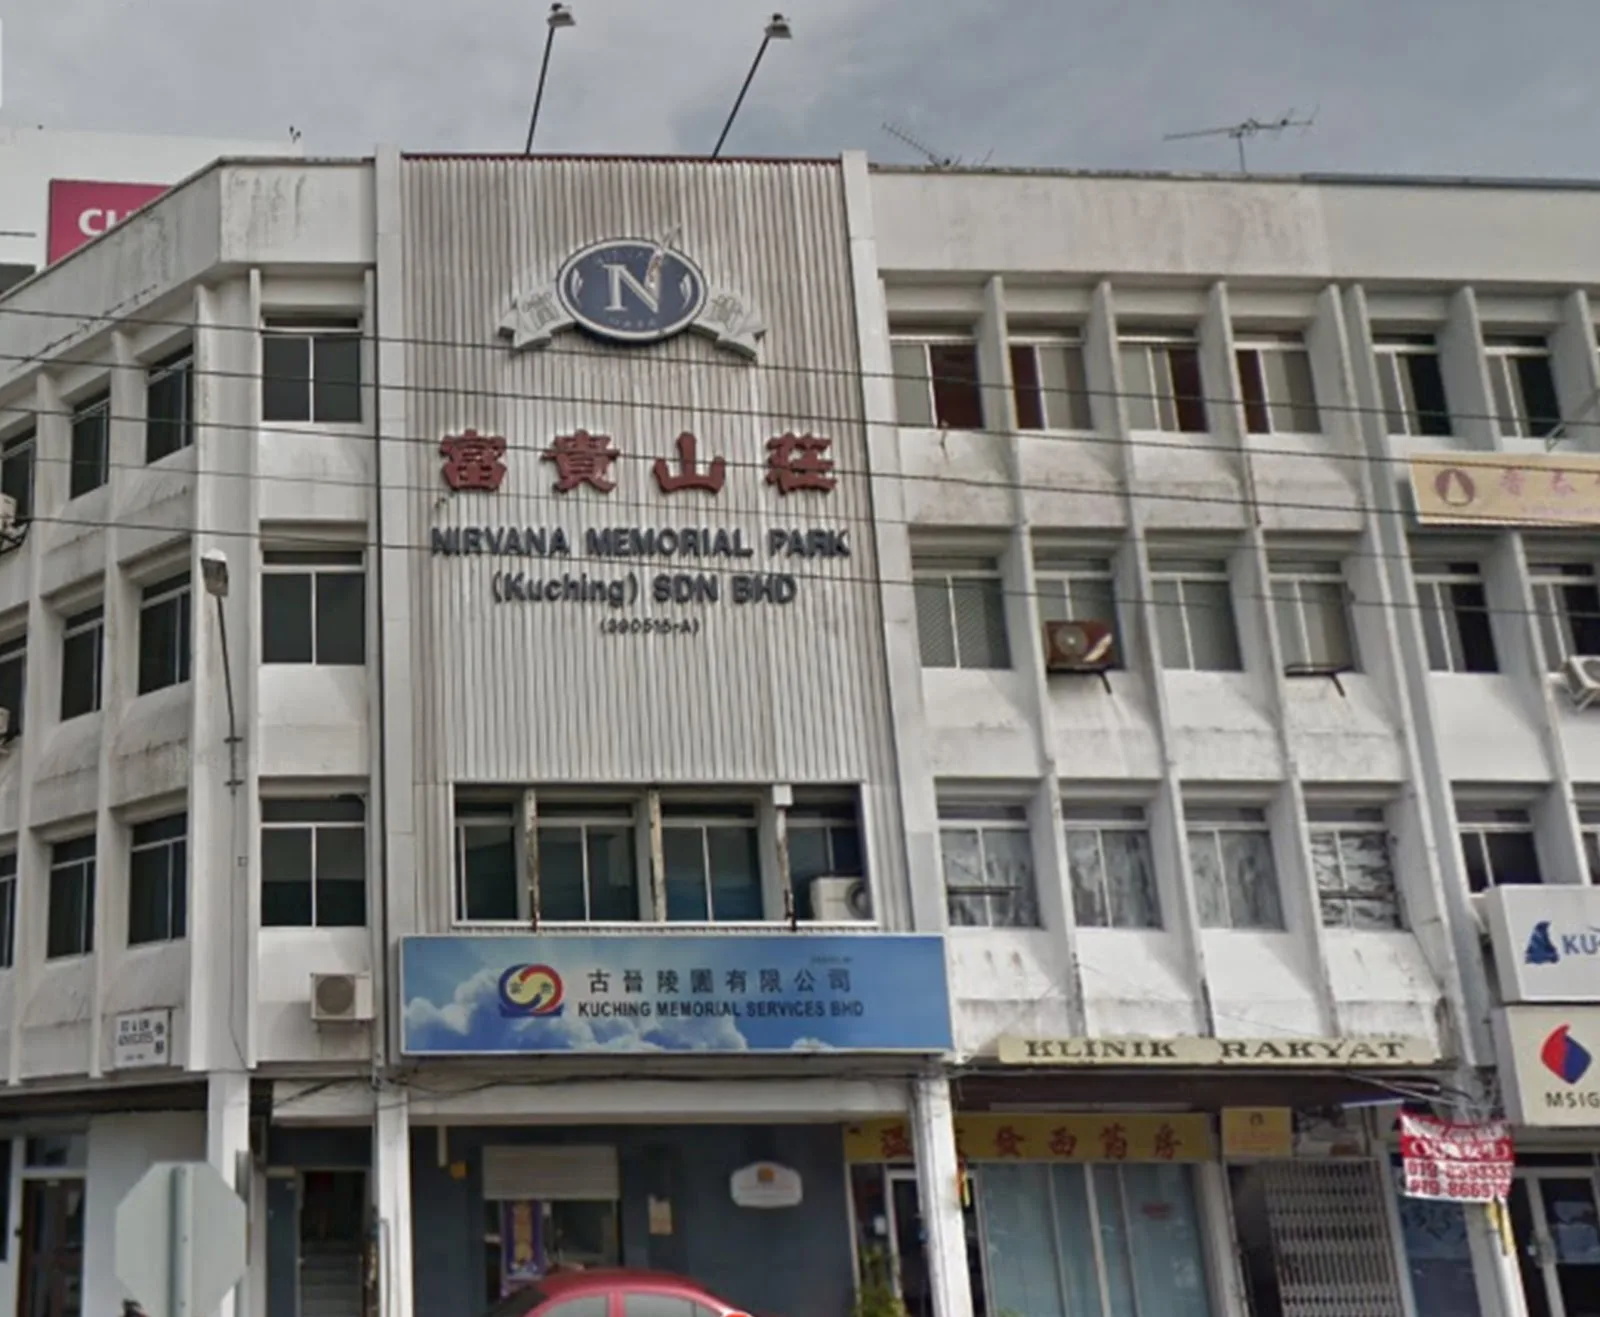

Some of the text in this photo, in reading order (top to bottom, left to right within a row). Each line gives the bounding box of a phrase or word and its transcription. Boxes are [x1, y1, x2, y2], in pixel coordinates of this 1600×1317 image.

[602, 264, 663, 313] N
[432, 527, 851, 558] NIRVANA MEMORIAL PARK
[492, 570, 797, 607] (Kuching) SDN BHD
[1561, 933, 1600, 956] KU
[577, 1001, 865, 1018] KUCHING MEMORIAL SERVICES BHD
[1024, 1040, 1406, 1060] KLINIK RAKYAT
[1545, 1092, 1600, 1109] MSIG
